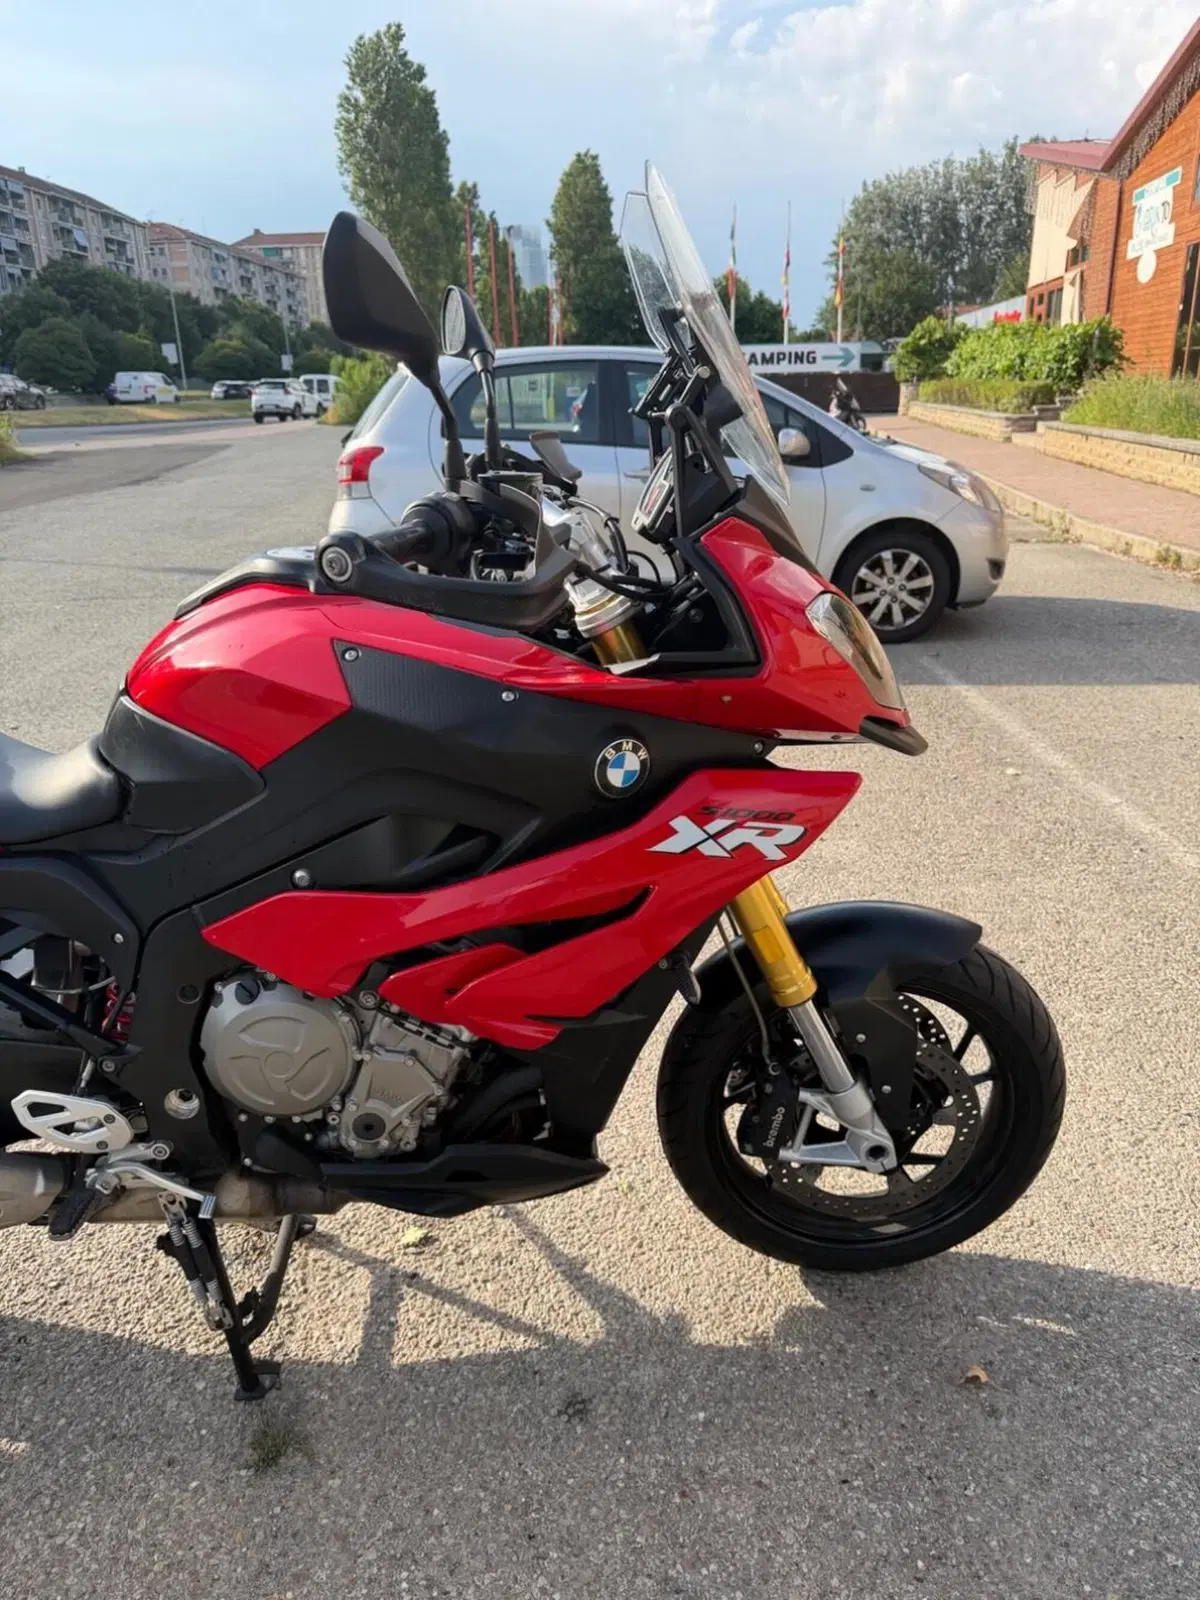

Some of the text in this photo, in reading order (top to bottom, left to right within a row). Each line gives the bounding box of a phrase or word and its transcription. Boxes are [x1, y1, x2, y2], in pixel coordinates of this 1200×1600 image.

[742, 351, 817, 366] AMPING
[604, 740, 648, 761] BMW
[643, 815, 808, 861] XR
[762, 1106, 786, 1148] brembo
